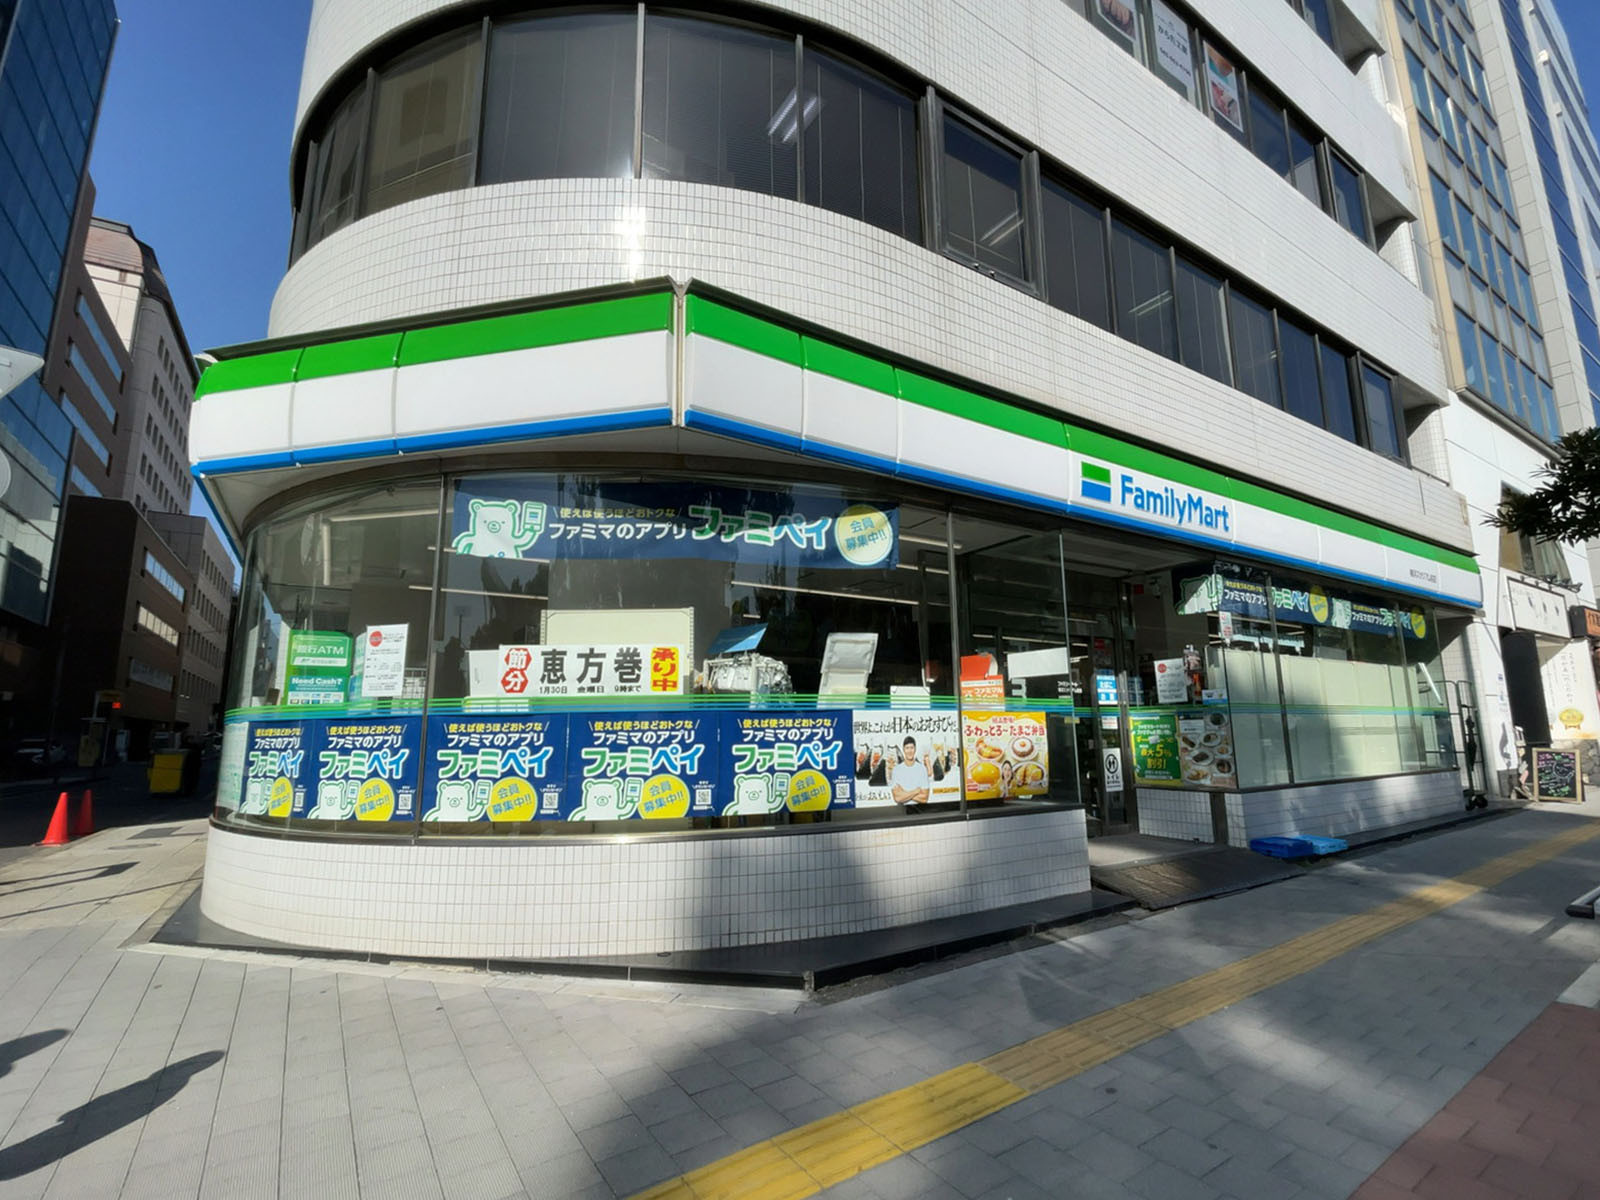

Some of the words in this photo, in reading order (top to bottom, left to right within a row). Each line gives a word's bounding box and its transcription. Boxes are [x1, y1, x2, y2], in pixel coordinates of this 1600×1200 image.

[1120, 474, 1229, 532] FamilyMart
[549, 521, 687, 540] ファミマのアプリ
[688, 504, 832, 549] ファミペイ
[849, 516, 876, 534] 会員
[504, 648, 526, 692] 節分
[539, 647, 643, 685] 恵方巻
[652, 647, 678, 692] 承り中
[291, 677, 314, 685] Need
[315, 677, 343, 685] Cash?
[539, 685, 568, 694] 1月30日
[577, 685, 605, 694] 金曜日
[614, 684, 642, 693] 9時まで
[448, 722, 543, 734] 使えば使うほどおトクな
[594, 720, 693, 731] 使えば使うほどおトクな
[742, 718, 832, 729] 使えば使うほどおトクな
[254, 736, 300, 749] ファミマのアプリ
[328, 735, 402, 749] ファミマのアプリ
[447, 732, 544, 748] ファミマのアプリ
[592, 729, 696, 746] ファミマのアプリ
[742, 727, 834, 742] ファミマのアプリ
[249, 749, 304, 778] ファミペイ
[319, 749, 409, 779] ファミペイ
[437, 746, 553, 779] ファミペイ
[581, 744, 705, 777] ファミペイ
[732, 740, 843, 773] ファミペイ
[497, 783, 521, 798] 会員
[649, 780, 672, 796] 会員
[796, 775, 816, 791] 会員
